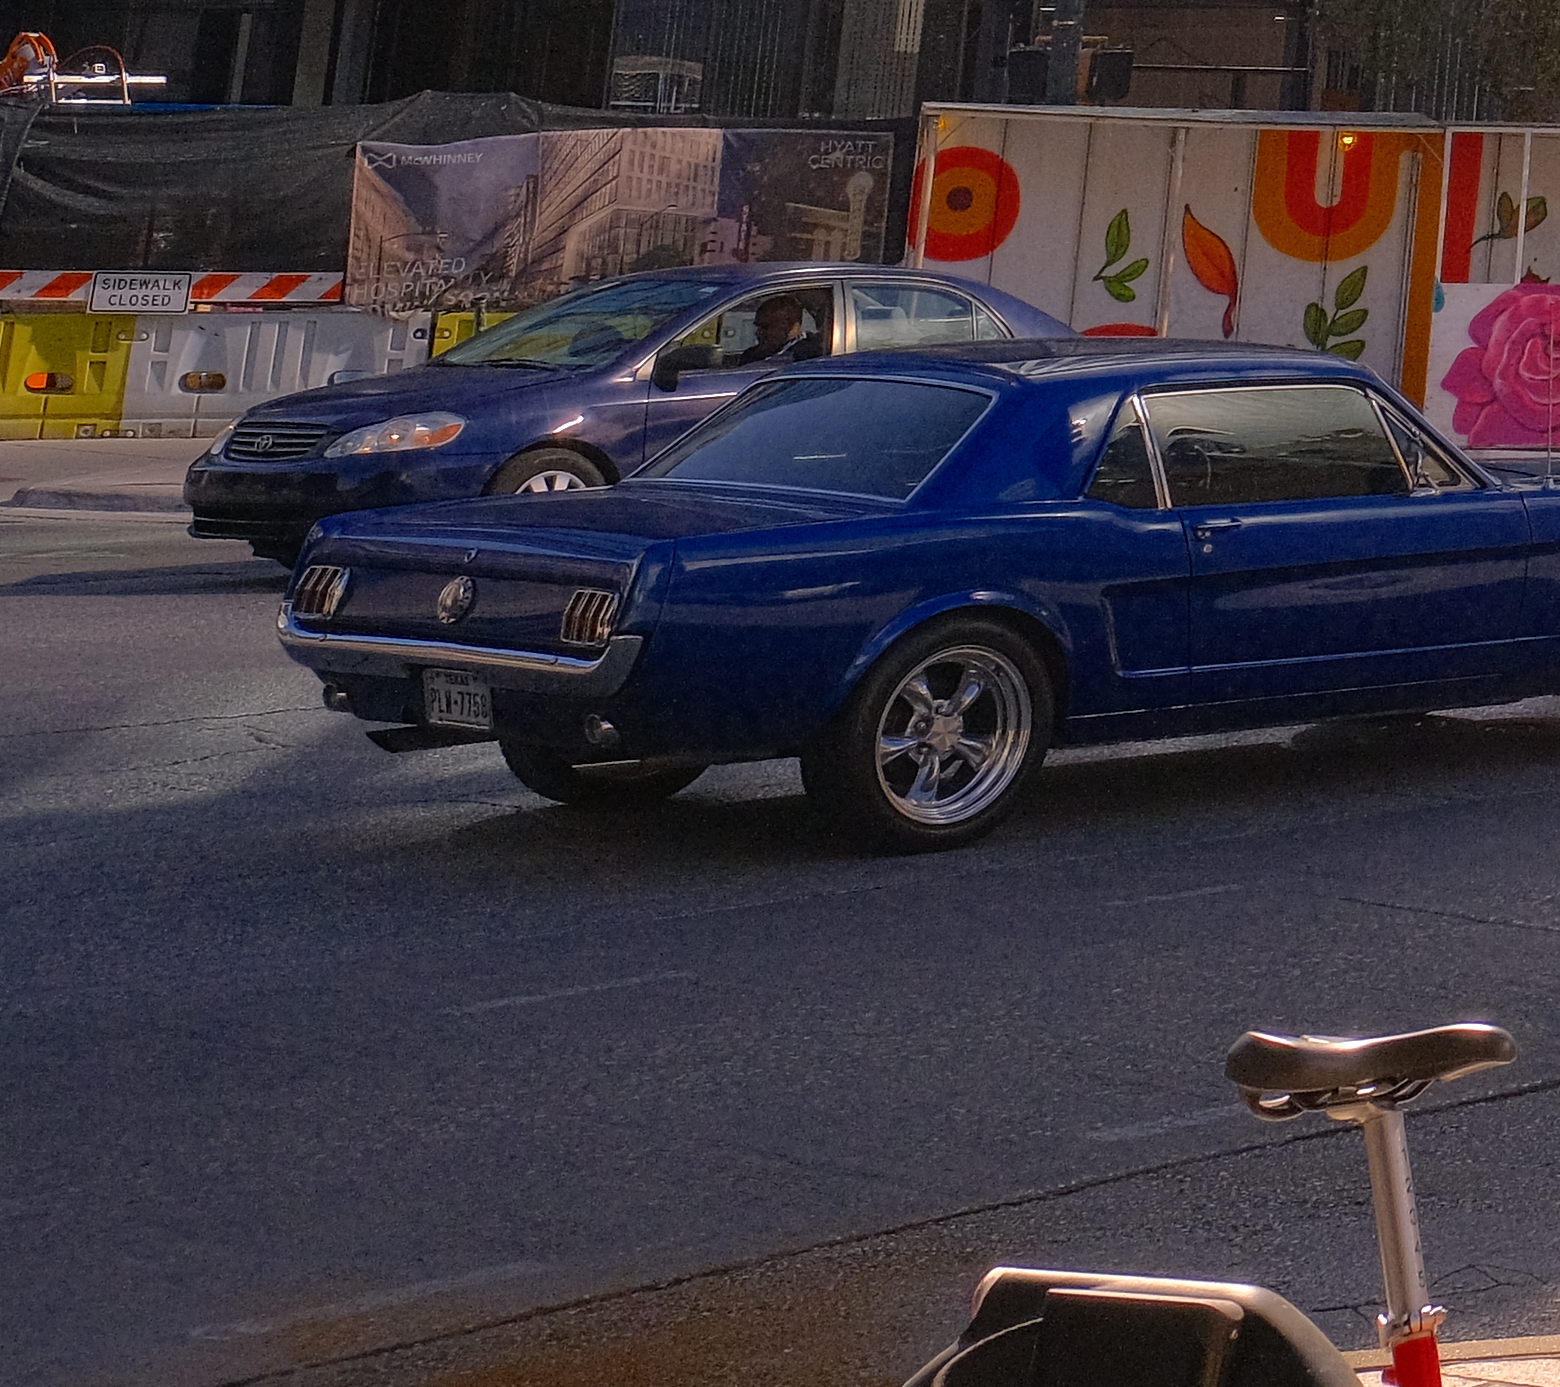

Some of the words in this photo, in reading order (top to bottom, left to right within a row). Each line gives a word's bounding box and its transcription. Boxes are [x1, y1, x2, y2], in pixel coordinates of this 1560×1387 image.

[821, 139, 877, 153] HYATT
[354, 256, 466, 278] ELEVATED
[101, 278, 182, 291] SIDEWALK
[108, 294, 171, 306] CLOSED
